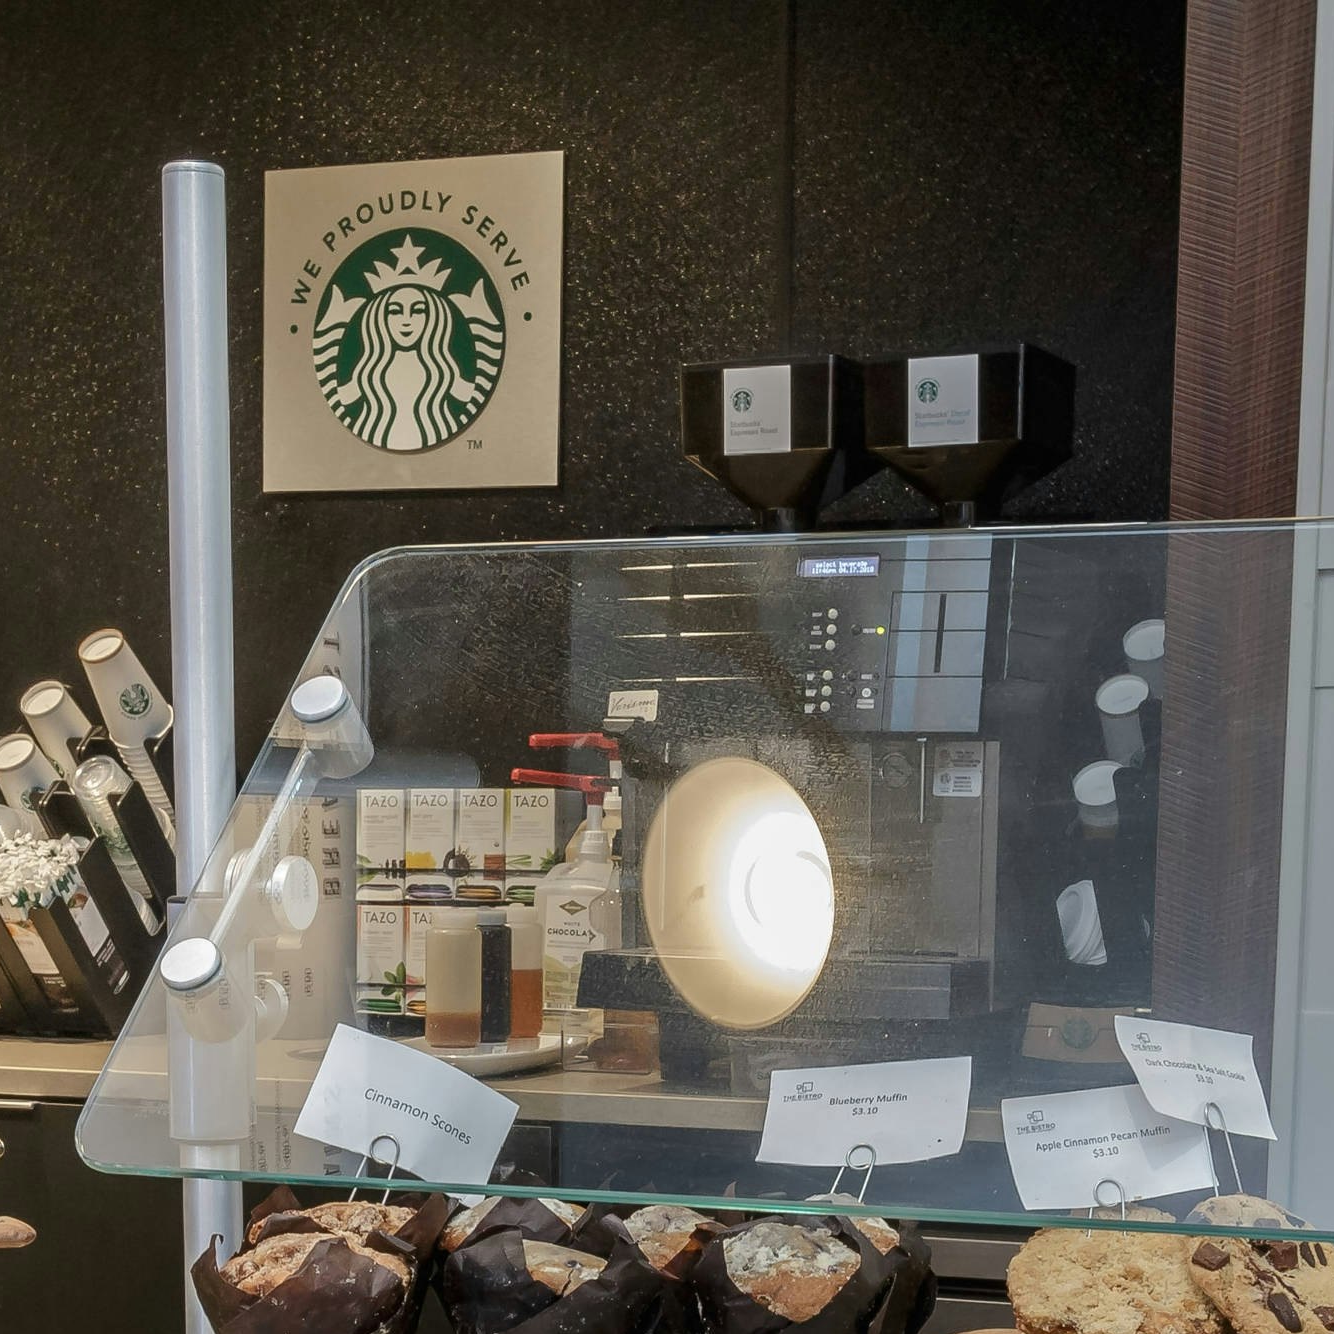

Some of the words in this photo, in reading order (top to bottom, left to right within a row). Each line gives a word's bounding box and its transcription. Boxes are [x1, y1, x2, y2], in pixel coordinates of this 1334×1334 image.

[291, 259, 322, 306] WE
[322, 190, 453, 253] PROUDLY
[461, 204, 531, 291] SERVE
[467, 439, 483, 450] TM
[364, 795, 399, 808] TAZO
[413, 794, 449, 807] TAZO
[462, 794, 498, 807] TAZO
[513, 795, 549, 808] TAZO
[363, 911, 397, 924] TAZO
[547, 927, 588, 937] CHOCOLA
[1145, 1058, 1162, 1068] Dark
[1163, 1058, 1197, 1071] Chocolate
[829, 1096, 874, 1106] Blueberry
[876, 1093, 908, 1102] Muffin
[364, 1087, 429, 1121] Cinnamon
[430, 1113, 472, 1145] Scones
[852, 1106, 878, 1116] $3.10
[1035, 1138, 1062, 1152] Apple
[1063, 1134, 1109, 1148] Cinnamon
[1110, 1130, 1138, 1142] Pecan
[1139, 1125, 1171, 1139] Muffin
[1092, 1146, 1119, 1159] $3.10
